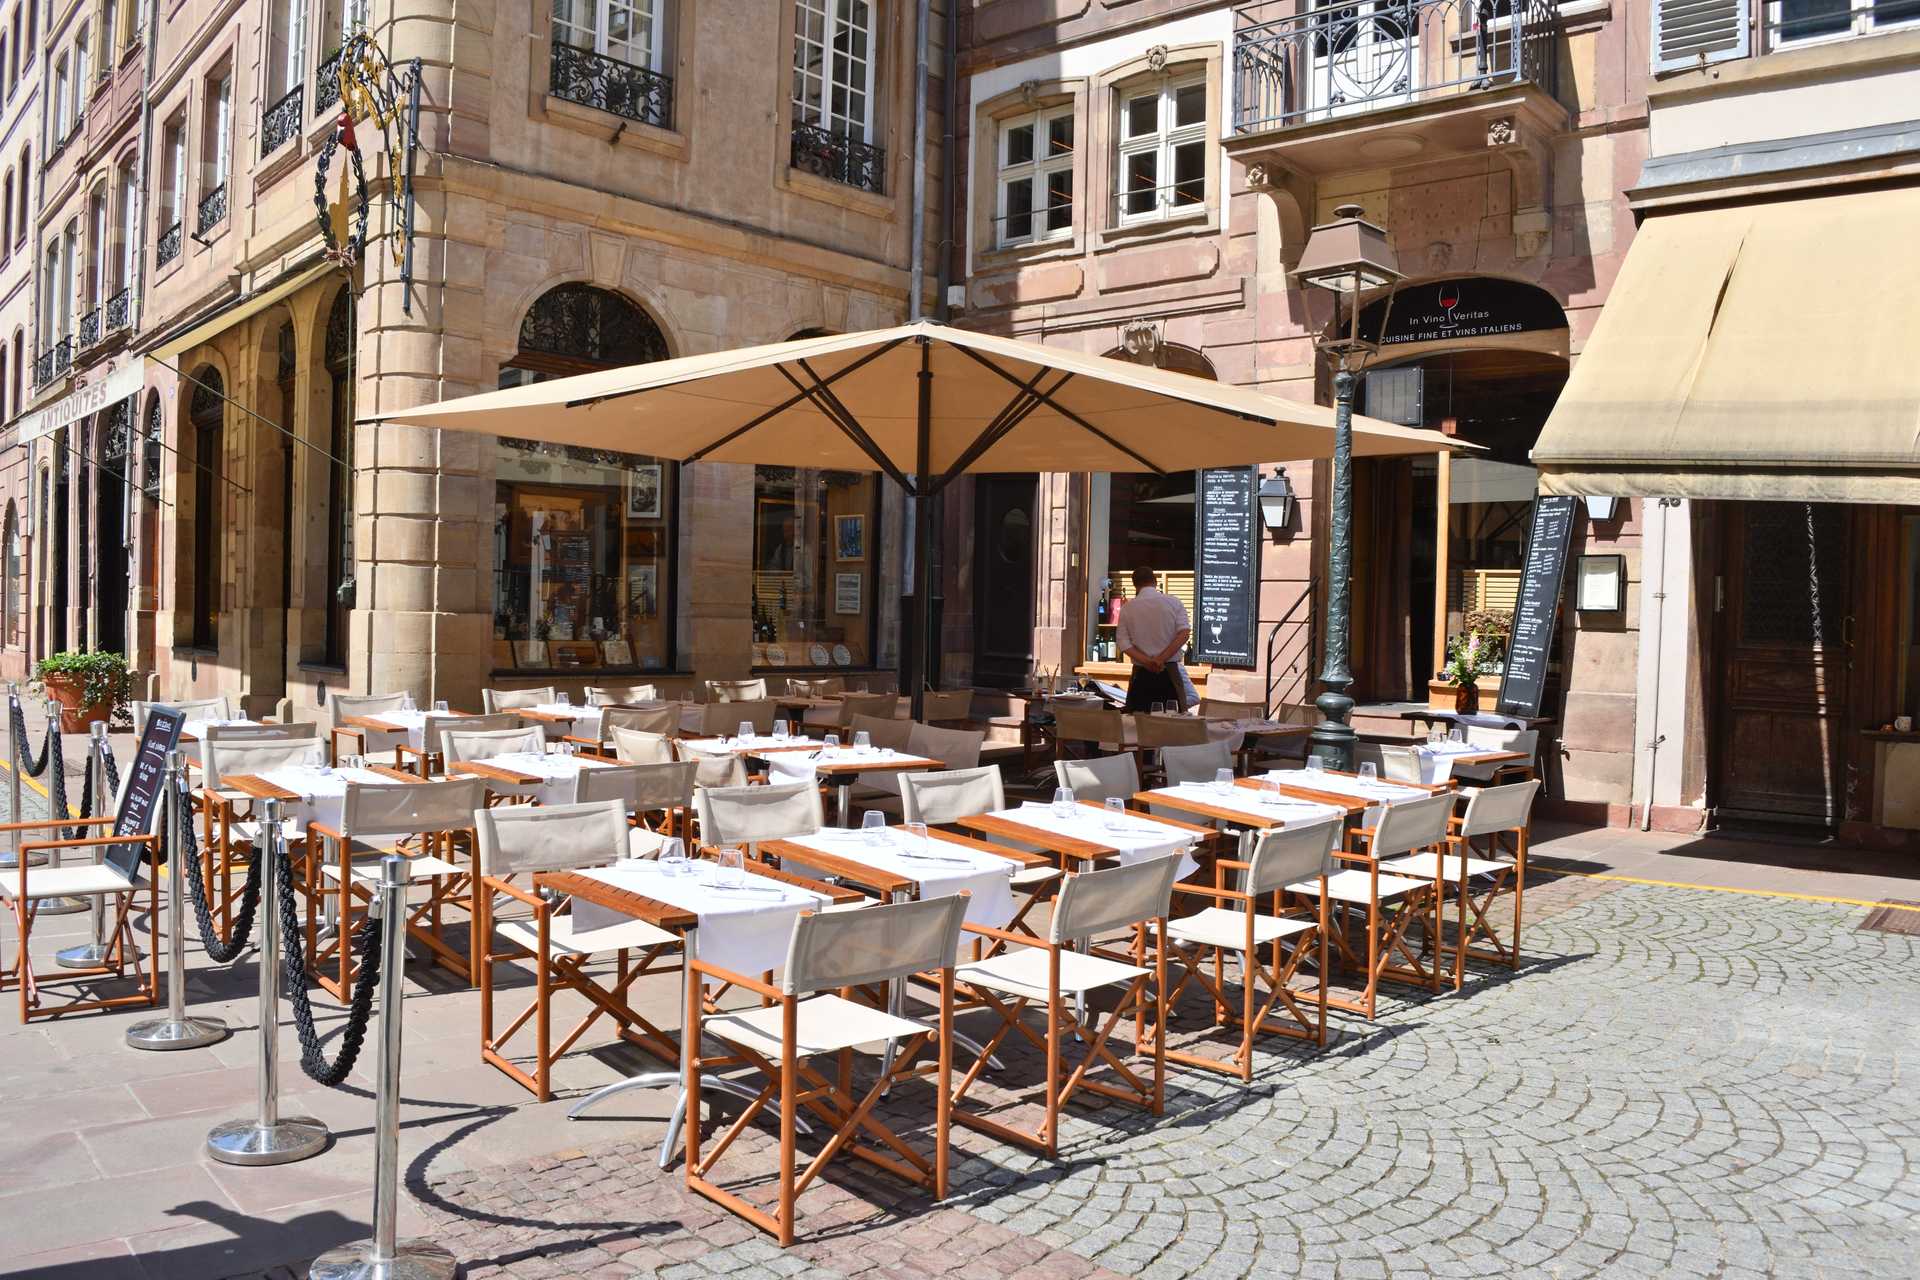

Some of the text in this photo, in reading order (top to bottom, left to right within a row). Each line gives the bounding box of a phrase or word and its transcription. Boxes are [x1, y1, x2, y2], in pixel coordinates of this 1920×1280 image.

[1410, 311, 1489, 325] In Vino Veritas
[1381, 323, 1522, 344] CUISINE FINE ET VINS ITALIENS
